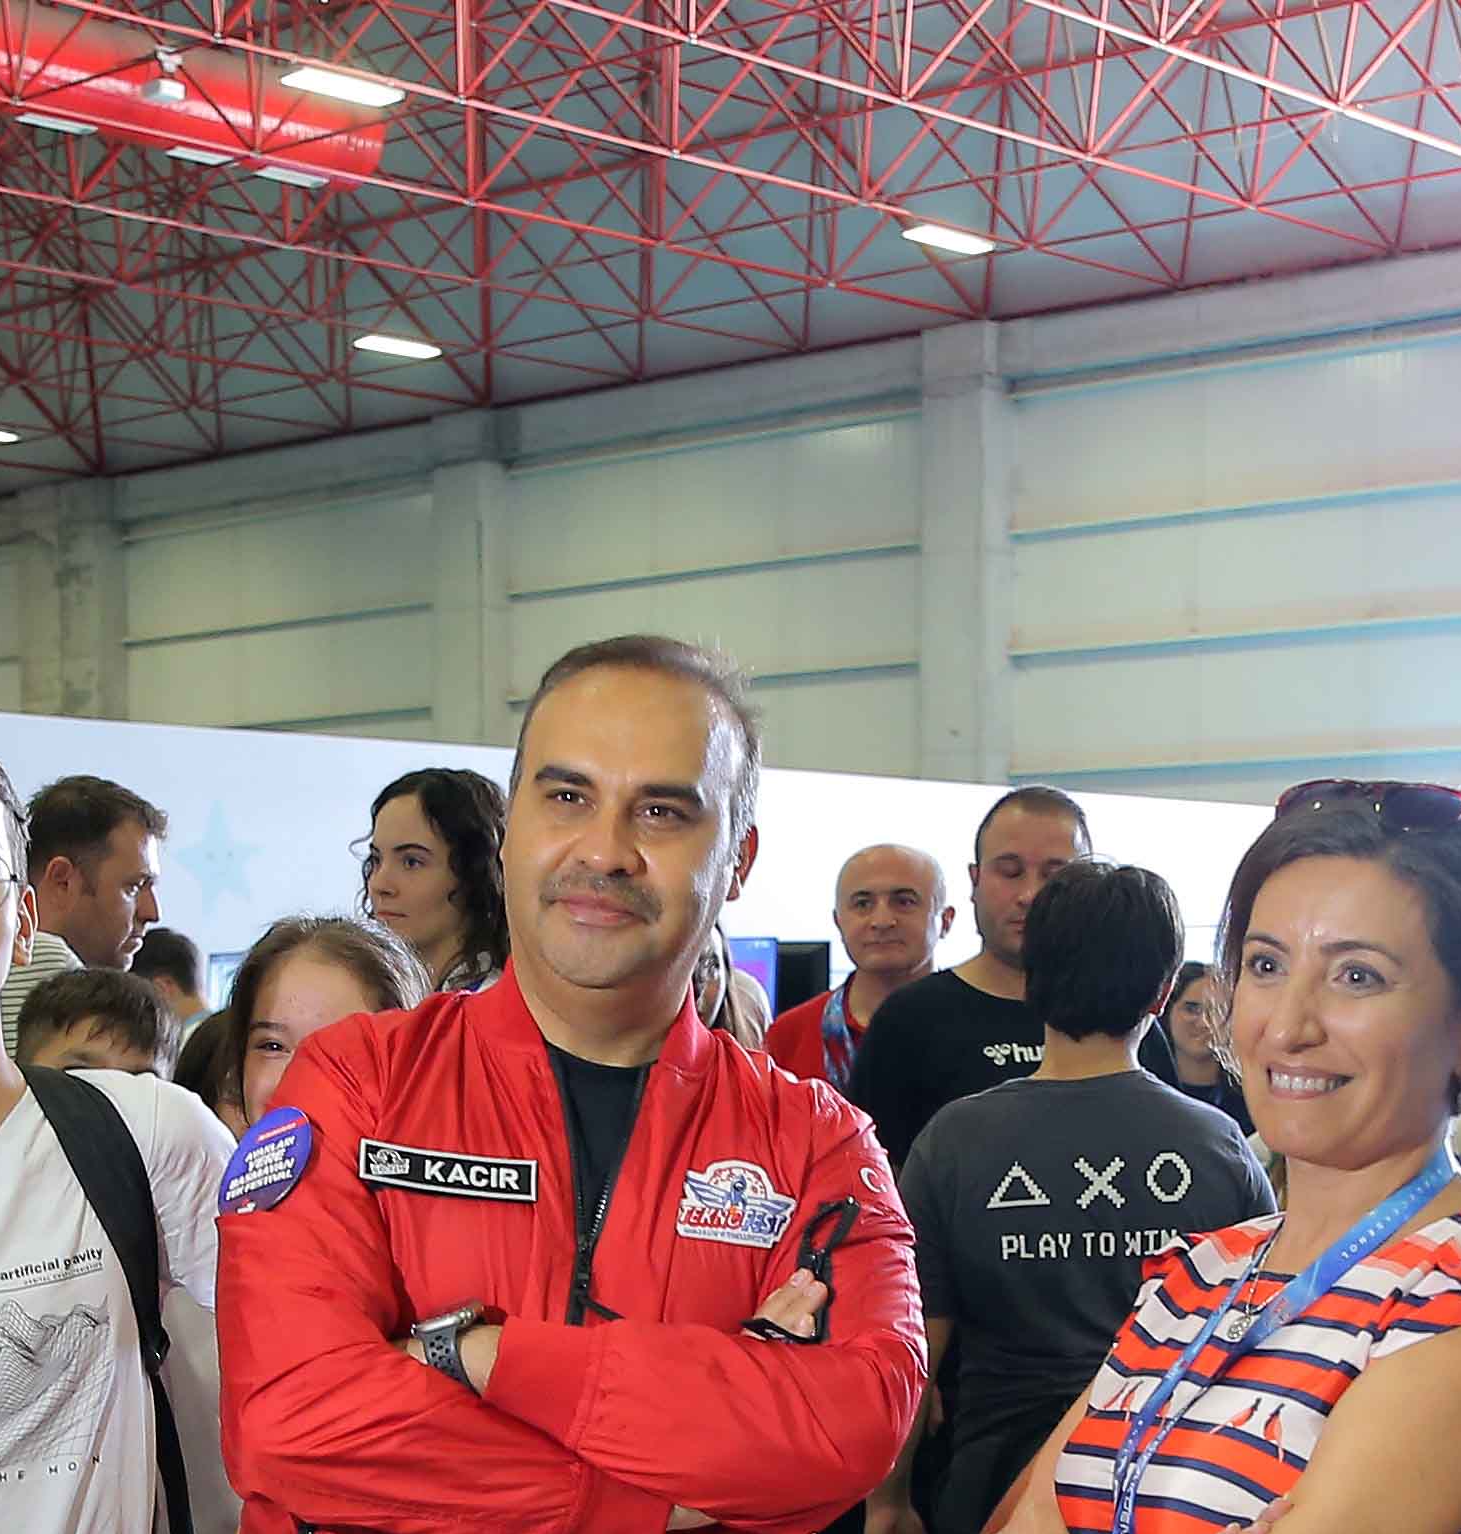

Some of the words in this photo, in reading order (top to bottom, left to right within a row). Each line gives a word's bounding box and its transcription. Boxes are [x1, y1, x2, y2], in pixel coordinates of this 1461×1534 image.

[1011, 1042, 1044, 1063] hu
[423, 1159, 521, 1191] KACIR
[678, 1205, 789, 1237] TEKNOFEST
[1001, 1232, 1072, 1261] PLAY
[1083, 1231, 1116, 1258] TO
[1125, 1228, 1179, 1257] WIN
[0, 1255, 60, 1282] artificial
